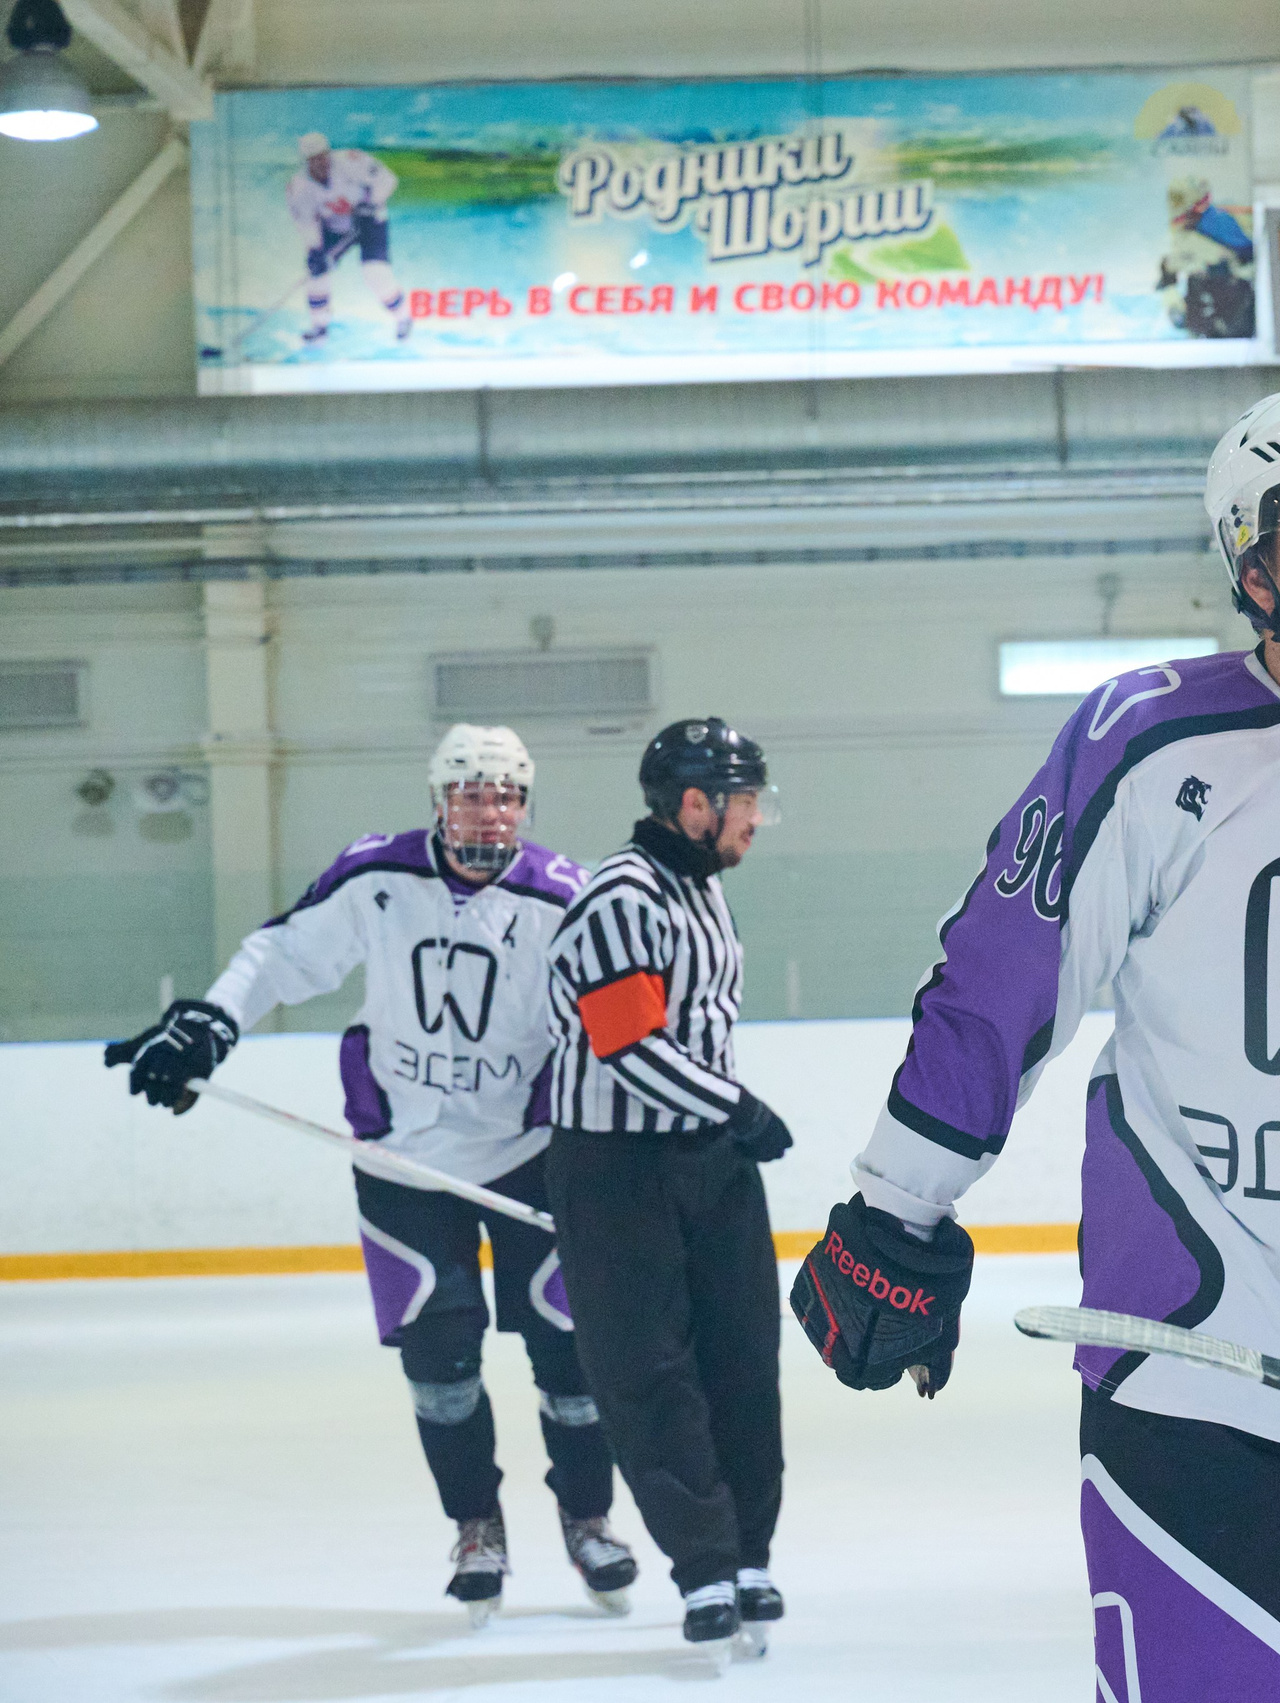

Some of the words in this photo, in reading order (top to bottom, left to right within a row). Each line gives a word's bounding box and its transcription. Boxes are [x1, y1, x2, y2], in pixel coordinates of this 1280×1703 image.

[560, 132, 853, 224] Родники
[699, 186, 933, 267] Шории
[409, 287, 513, 320] ВЕРЬ
[527, 285, 552, 316] В
[568, 284, 675, 315] СЕБЯ
[689, 284, 719, 314] И
[733, 278, 861, 313] СВОЮ
[876, 273, 1105, 311] КОМАНДУ!
[824, 1230, 936, 1316] Reebok
